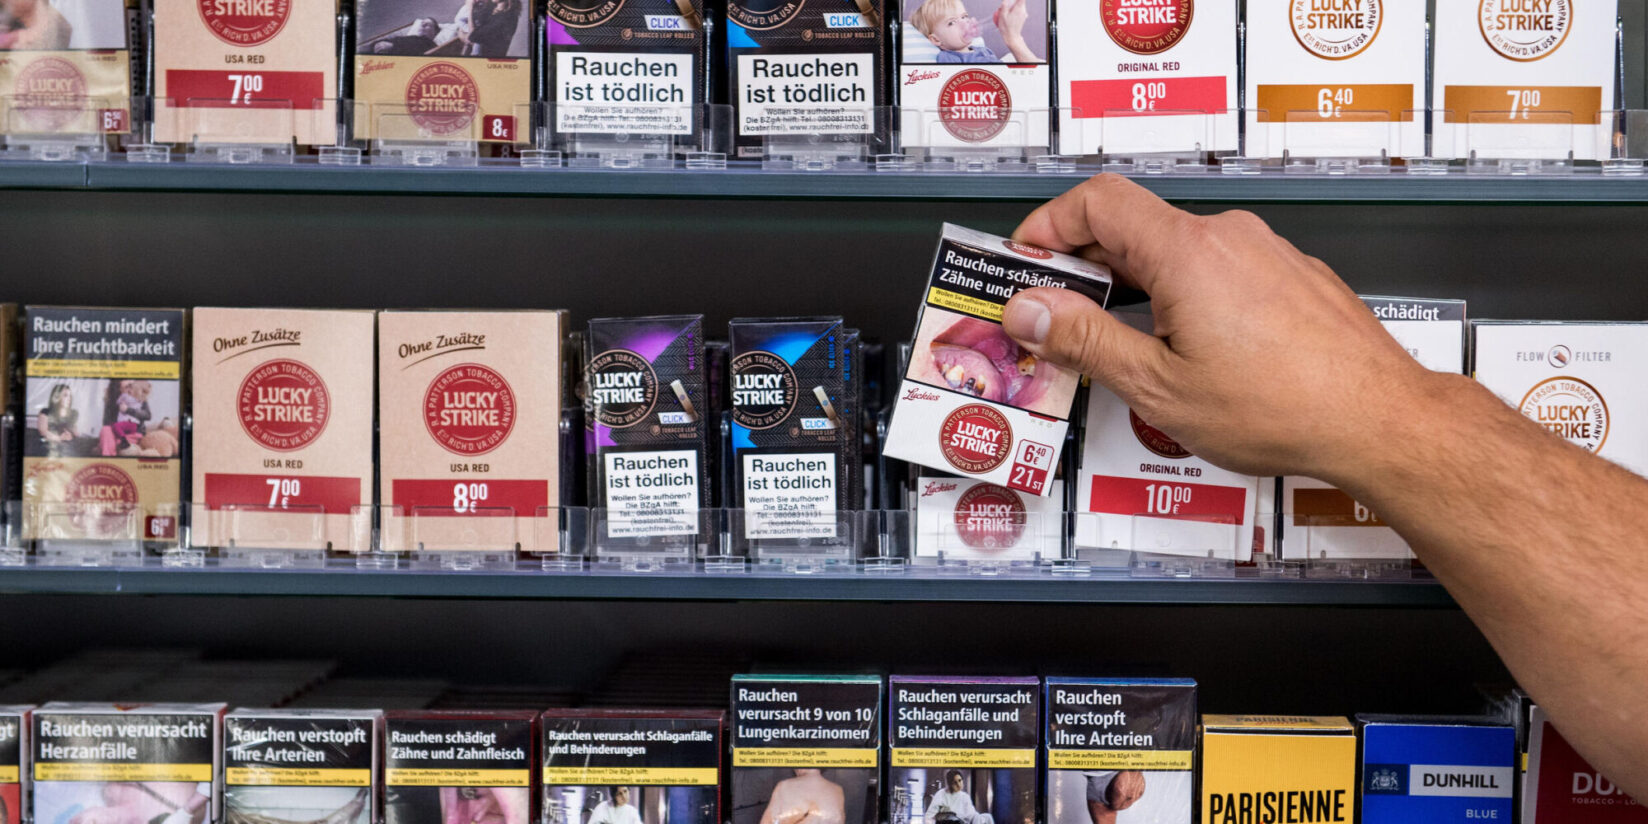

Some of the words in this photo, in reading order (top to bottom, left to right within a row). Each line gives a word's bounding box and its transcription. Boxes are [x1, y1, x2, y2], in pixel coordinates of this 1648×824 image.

[1500, 0, 1552, 12] LUCKY
[829, 16, 859, 26] CLICK
[1117, 6, 1176, 24] STRIKE
[1307, 13, 1364, 29] STRIKE
[1496, 15, 1553, 30] STRIKE
[650, 18, 680, 28] CLICK
[225, 55, 244, 64] USA
[247, 55, 265, 64] RED
[572, 56, 678, 76] Rauchen
[1117, 63, 1159, 72] ORIGINAL
[1162, 62, 1180, 70] RED
[752, 58, 858, 78] Rauchen
[904, 69, 940, 85] Luckies
[422, 84, 466, 97] LUCKY
[565, 82, 594, 102] ist
[601, 82, 684, 102] tödlich
[747, 84, 775, 103] ist
[783, 84, 865, 103] tödlich
[954, 91, 997, 105] LUCKY
[418, 99, 466, 112] STRIKE
[951, 106, 998, 119] STRIKE
[945, 250, 1004, 277] Rauchen
[1006, 269, 1067, 289] schädigt
[940, 268, 983, 291] Zähne
[986, 285, 1014, 298] und
[936, 290, 953, 298] Wollen
[1374, 303, 1439, 320] schädigt
[33, 316, 100, 333] Rauchen
[105, 318, 169, 334] mindert
[33, 337, 63, 353] Ihre
[68, 337, 175, 355] Fruchtbarkeit
[213, 336, 247, 353] Ohne
[251, 328, 301, 344] Zusätze
[398, 341, 432, 358] Ohne
[436, 333, 486, 349] Zusätze
[614, 354, 645, 370] TOBACCO
[755, 356, 785, 373] TOBACCO
[1516, 352, 1544, 361] FLOW
[1576, 352, 1611, 362] FILTER
[242, 365, 278, 403] PATTERSON
[282, 364, 316, 386] TOBACCO
[595, 372, 642, 387] LUCKY
[735, 374, 783, 389] LUCKY
[258, 387, 312, 404] LUCKY
[428, 369, 464, 408] PATTERSON
[466, 368, 501, 389] TOBACCO
[902, 388, 941, 401] Luckies
[443, 392, 497, 409] LUCKY
[593, 388, 645, 404] STRIKE
[733, 390, 784, 405] STRIKE
[254, 405, 313, 422] STRIKE
[440, 409, 499, 426] STRIKE
[1524, 384, 1556, 416] ATTERSON
[1560, 382, 1594, 402] TOBACCO
[1592, 403, 1603, 440] COMPANY
[1537, 406, 1590, 421] LUCKY
[662, 415, 684, 423] CLICK
[805, 420, 827, 428] CLICK
[946, 407, 979, 431] PATTERSON
[981, 409, 1006, 429] TOBACCO
[957, 421, 1000, 442] LUCKY
[1543, 423, 1590, 438] TRIKE
[950, 434, 998, 456] STRIKE
[263, 460, 282, 468] USA
[285, 460, 303, 469] RED
[450, 464, 469, 472] USA
[472, 464, 490, 472] RED
[613, 456, 688, 470] Rauchen
[752, 458, 826, 472] Rauchen
[1140, 463, 1181, 475] ORIGINAL
[1184, 467, 1202, 477] RED
[610, 475, 630, 488] ist
[635, 472, 693, 487] tödlich
[748, 477, 768, 490] ist
[774, 475, 831, 489] tödlich
[1012, 466, 1034, 488] 21
[1032, 481, 1043, 491] ST
[81, 485, 123, 498] LUCKY
[970, 504, 1012, 517] LUCKY
[967, 518, 1013, 532] STRIKE
[739, 688, 797, 702] Rauchen
[899, 690, 956, 703] Rauchen
[960, 690, 1031, 704] verursacht
[1056, 690, 1122, 705] Rauchen
[739, 707, 810, 721] verursacht
[814, 708, 822, 721] 9
[825, 711, 851, 721] von
[855, 708, 871, 721] 10
[899, 708, 989, 724] Schlaganfälle
[993, 708, 1019, 722] und
[1055, 710, 1126, 728] verstopft
[40, 721, 112, 738] Rauchen
[118, 721, 207, 738] verursacht
[232, 726, 295, 742] Rauchen
[299, 727, 366, 746] verstopft
[549, 730, 591, 741] Rauchen
[593, 730, 645, 741] verursacht
[647, 730, 713, 743] Schlaganfälle
[738, 725, 869, 742] Lungenkarzinomen
[899, 726, 1002, 742] Behinderungen
[391, 730, 442, 743] Rauchen
[445, 731, 497, 747] schädigt
[1055, 730, 1085, 745] Ihre
[1089, 731, 1153, 746] Arterien
[40, 743, 137, 760] Herzanfälle
[232, 748, 261, 761] Ihre
[264, 747, 325, 761] Arterien
[391, 747, 428, 759] Zähne
[431, 747, 454, 759] und
[456, 747, 525, 760] Zahnfleisch
[549, 744, 568, 754] und
[570, 744, 646, 757] Behinderungen
[1423, 774, 1498, 789] DUNHILL
[1210, 789, 1346, 824] PARISIENNE
[1466, 809, 1498, 818] BLUE
